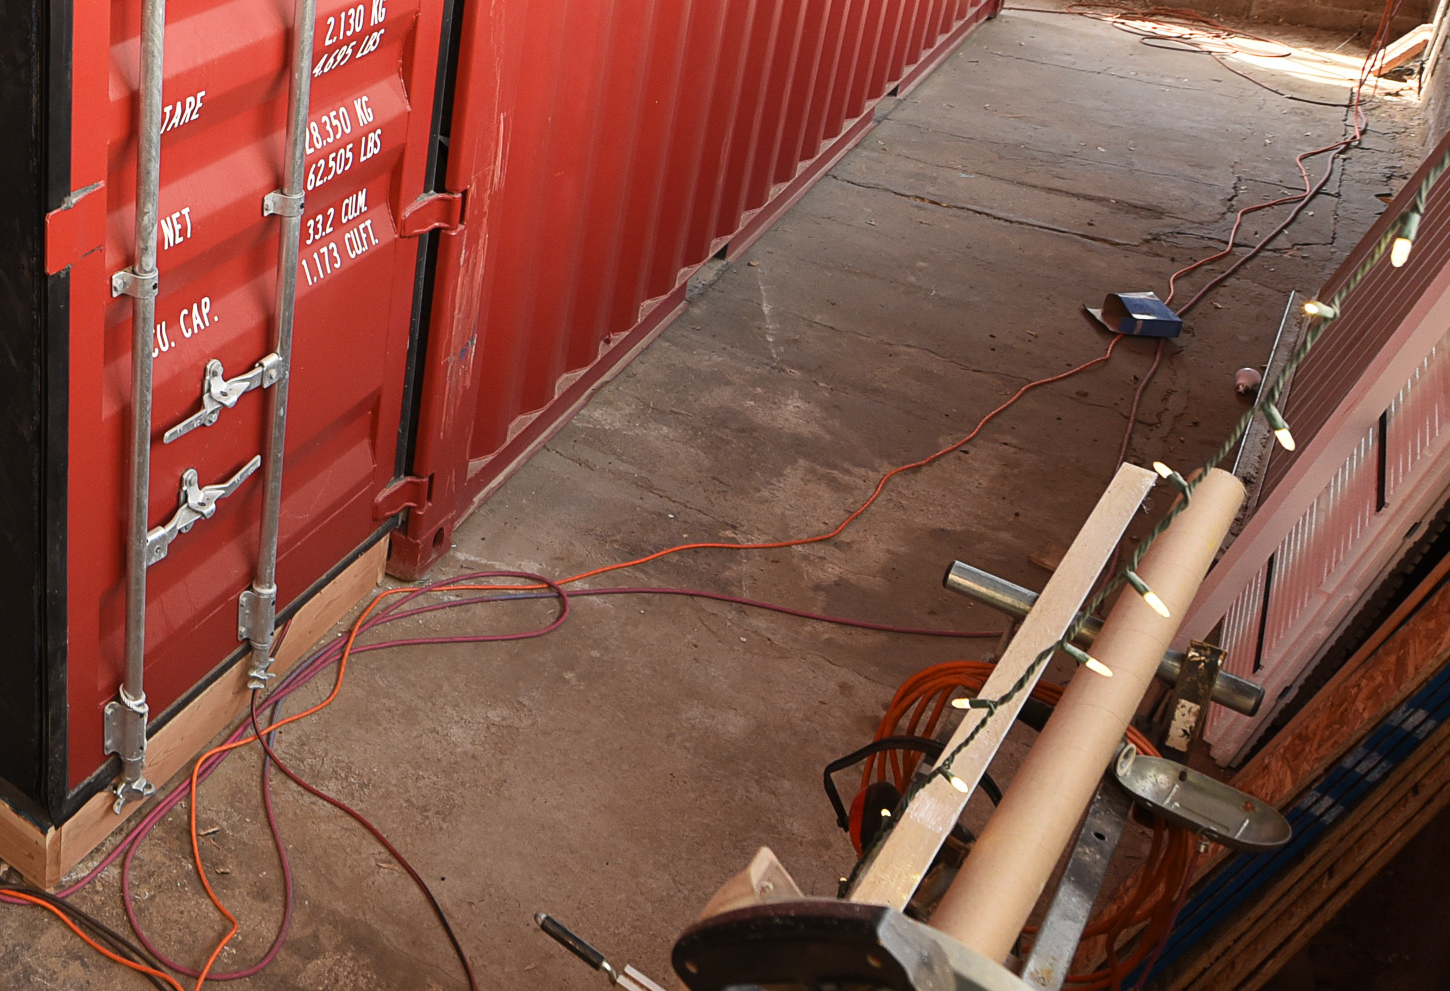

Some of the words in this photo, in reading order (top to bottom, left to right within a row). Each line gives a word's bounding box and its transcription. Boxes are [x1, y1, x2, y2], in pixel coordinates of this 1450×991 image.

[160, 91, 206, 135] TARE
[324, 4, 365, 47] 2.130
[312, 40, 357, 78] 4.695
[355, 28, 386, 59] LBS
[160, 207, 193, 250] NET
[353, 95, 374, 127] KG
[307, 143, 354, 191] 62.505
[359, 128, 382, 163] LBS
[179, 297, 220, 339] CAP.
[306, 207, 335, 246] 33.2
[302, 241, 342, 286] 1.173
